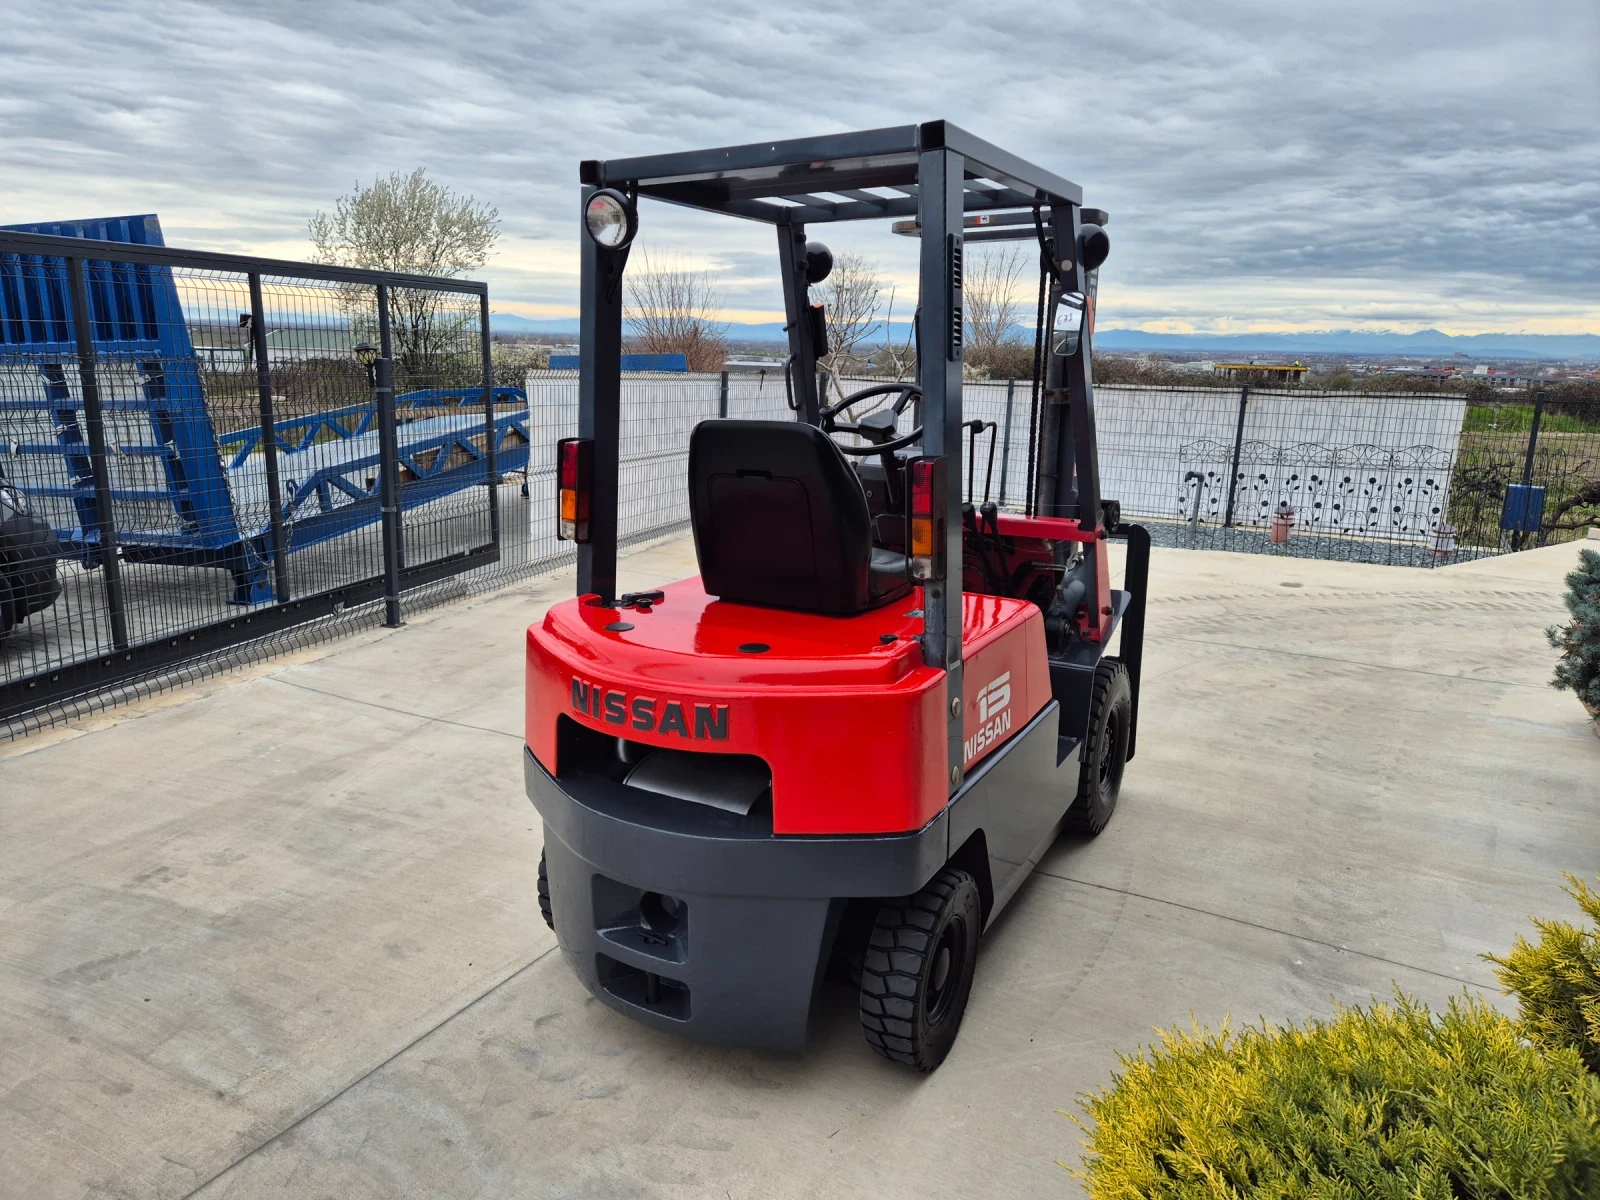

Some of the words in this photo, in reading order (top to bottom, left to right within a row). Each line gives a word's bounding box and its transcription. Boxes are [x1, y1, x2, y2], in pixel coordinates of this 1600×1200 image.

[571, 675, 729, 740] NISSAN
[976, 671, 1010, 724] 15
[963, 708, 1010, 764] NISSAN
